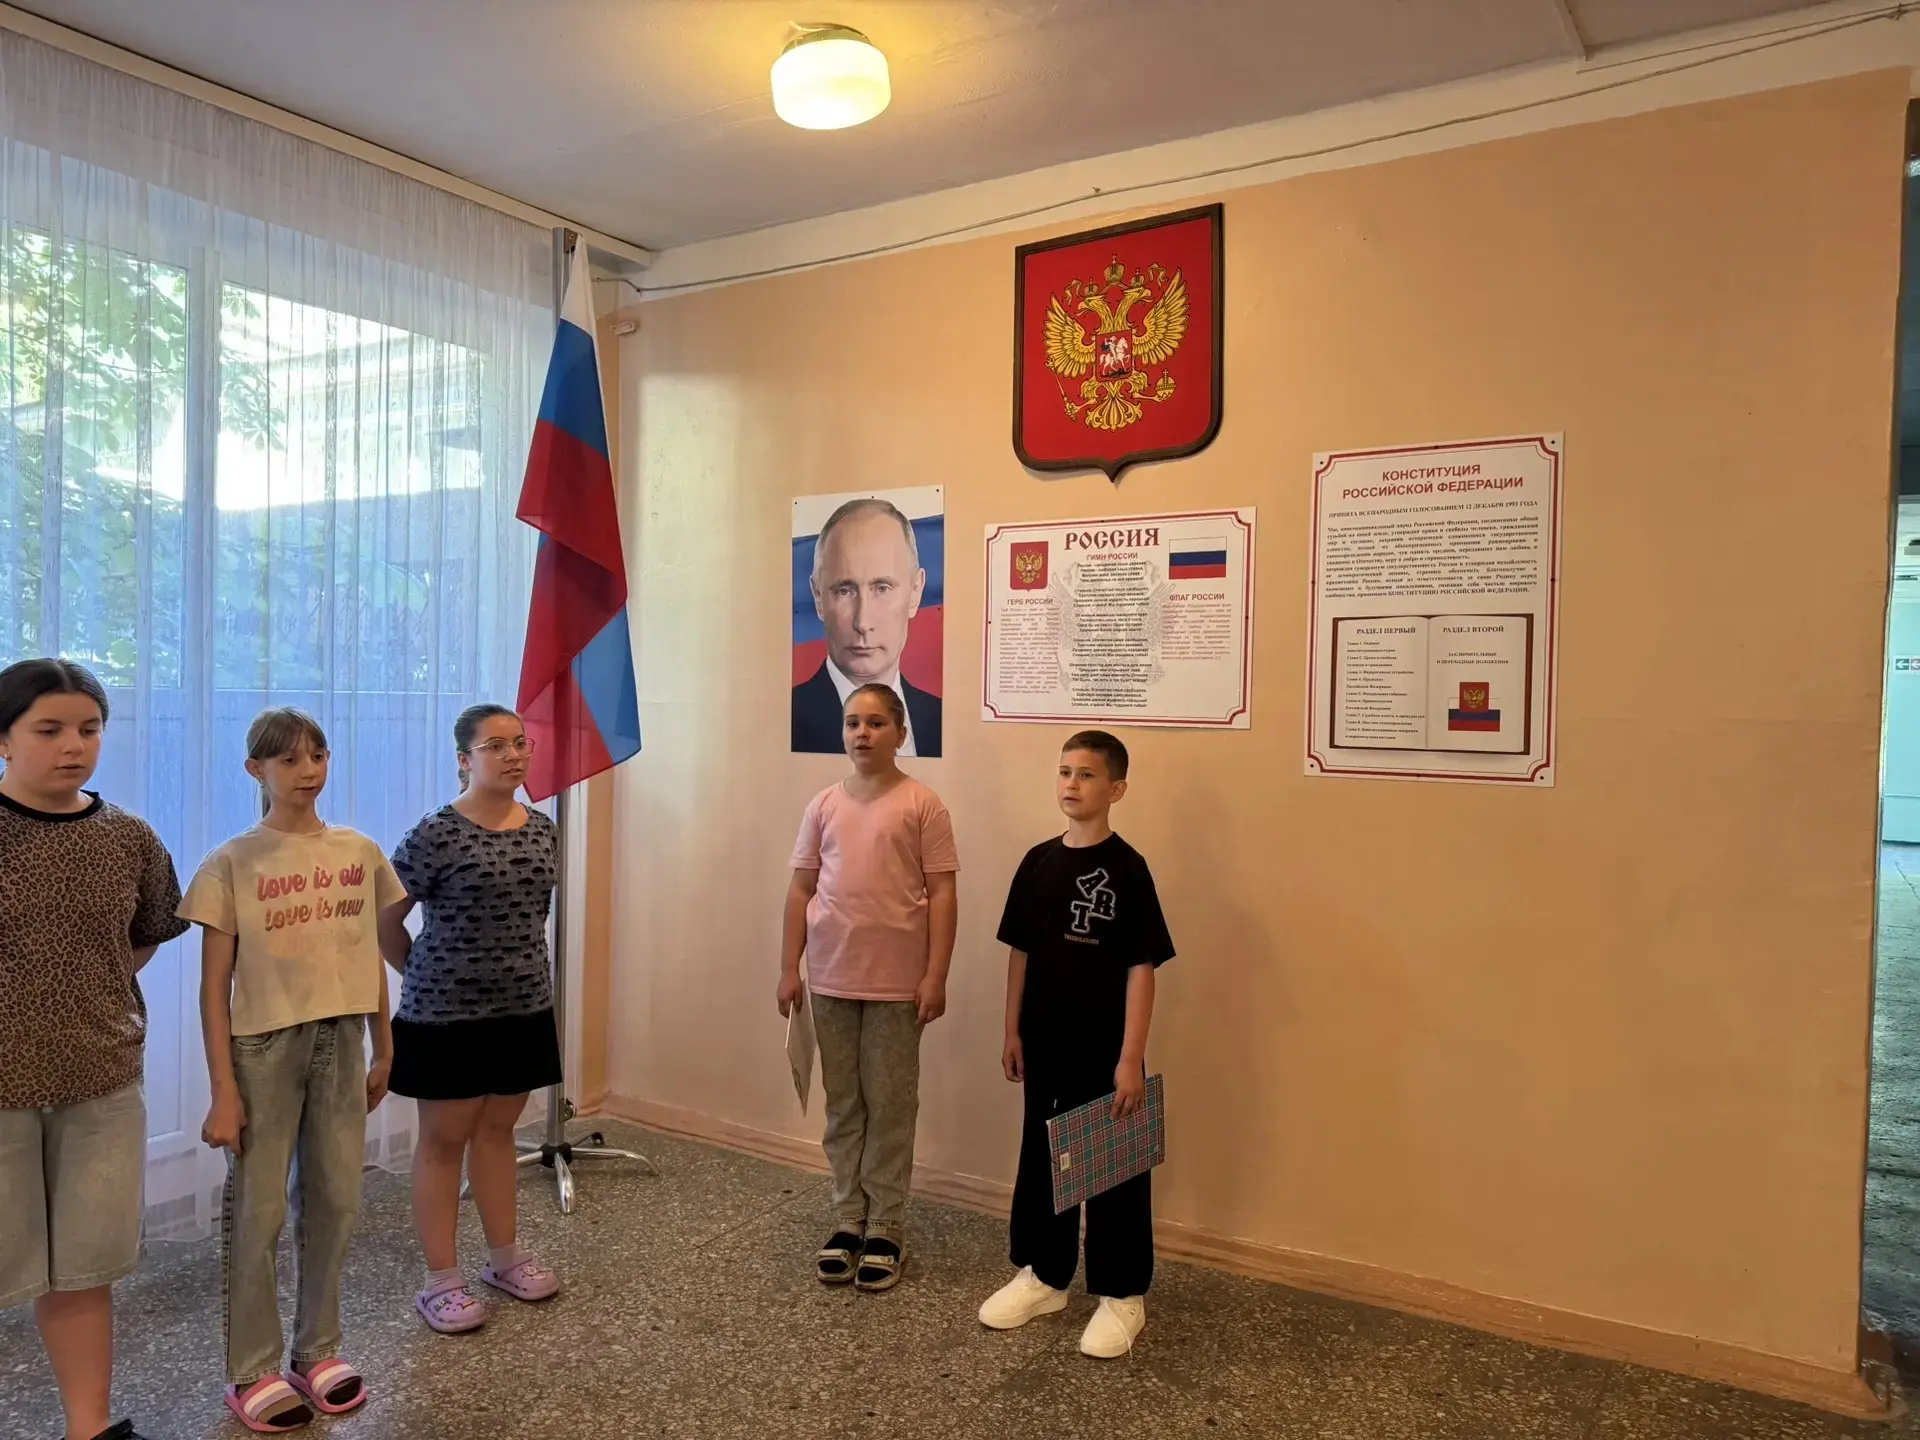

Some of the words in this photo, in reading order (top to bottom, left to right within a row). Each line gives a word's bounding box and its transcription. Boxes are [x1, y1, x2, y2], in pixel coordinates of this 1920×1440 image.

[1382, 464, 1481, 482] КОНСТИТУЦИЯ
[1342, 481, 1433, 500] РОССИЙСКОЙ
[1437, 477, 1524, 493] ФЕДЕРАЦИИ
[1064, 528, 1160, 550] РОССИЯ
[314, 866, 333, 889] is
[339, 864, 365, 886] old
[316, 897, 333, 920] is
[335, 899, 364, 918] new
